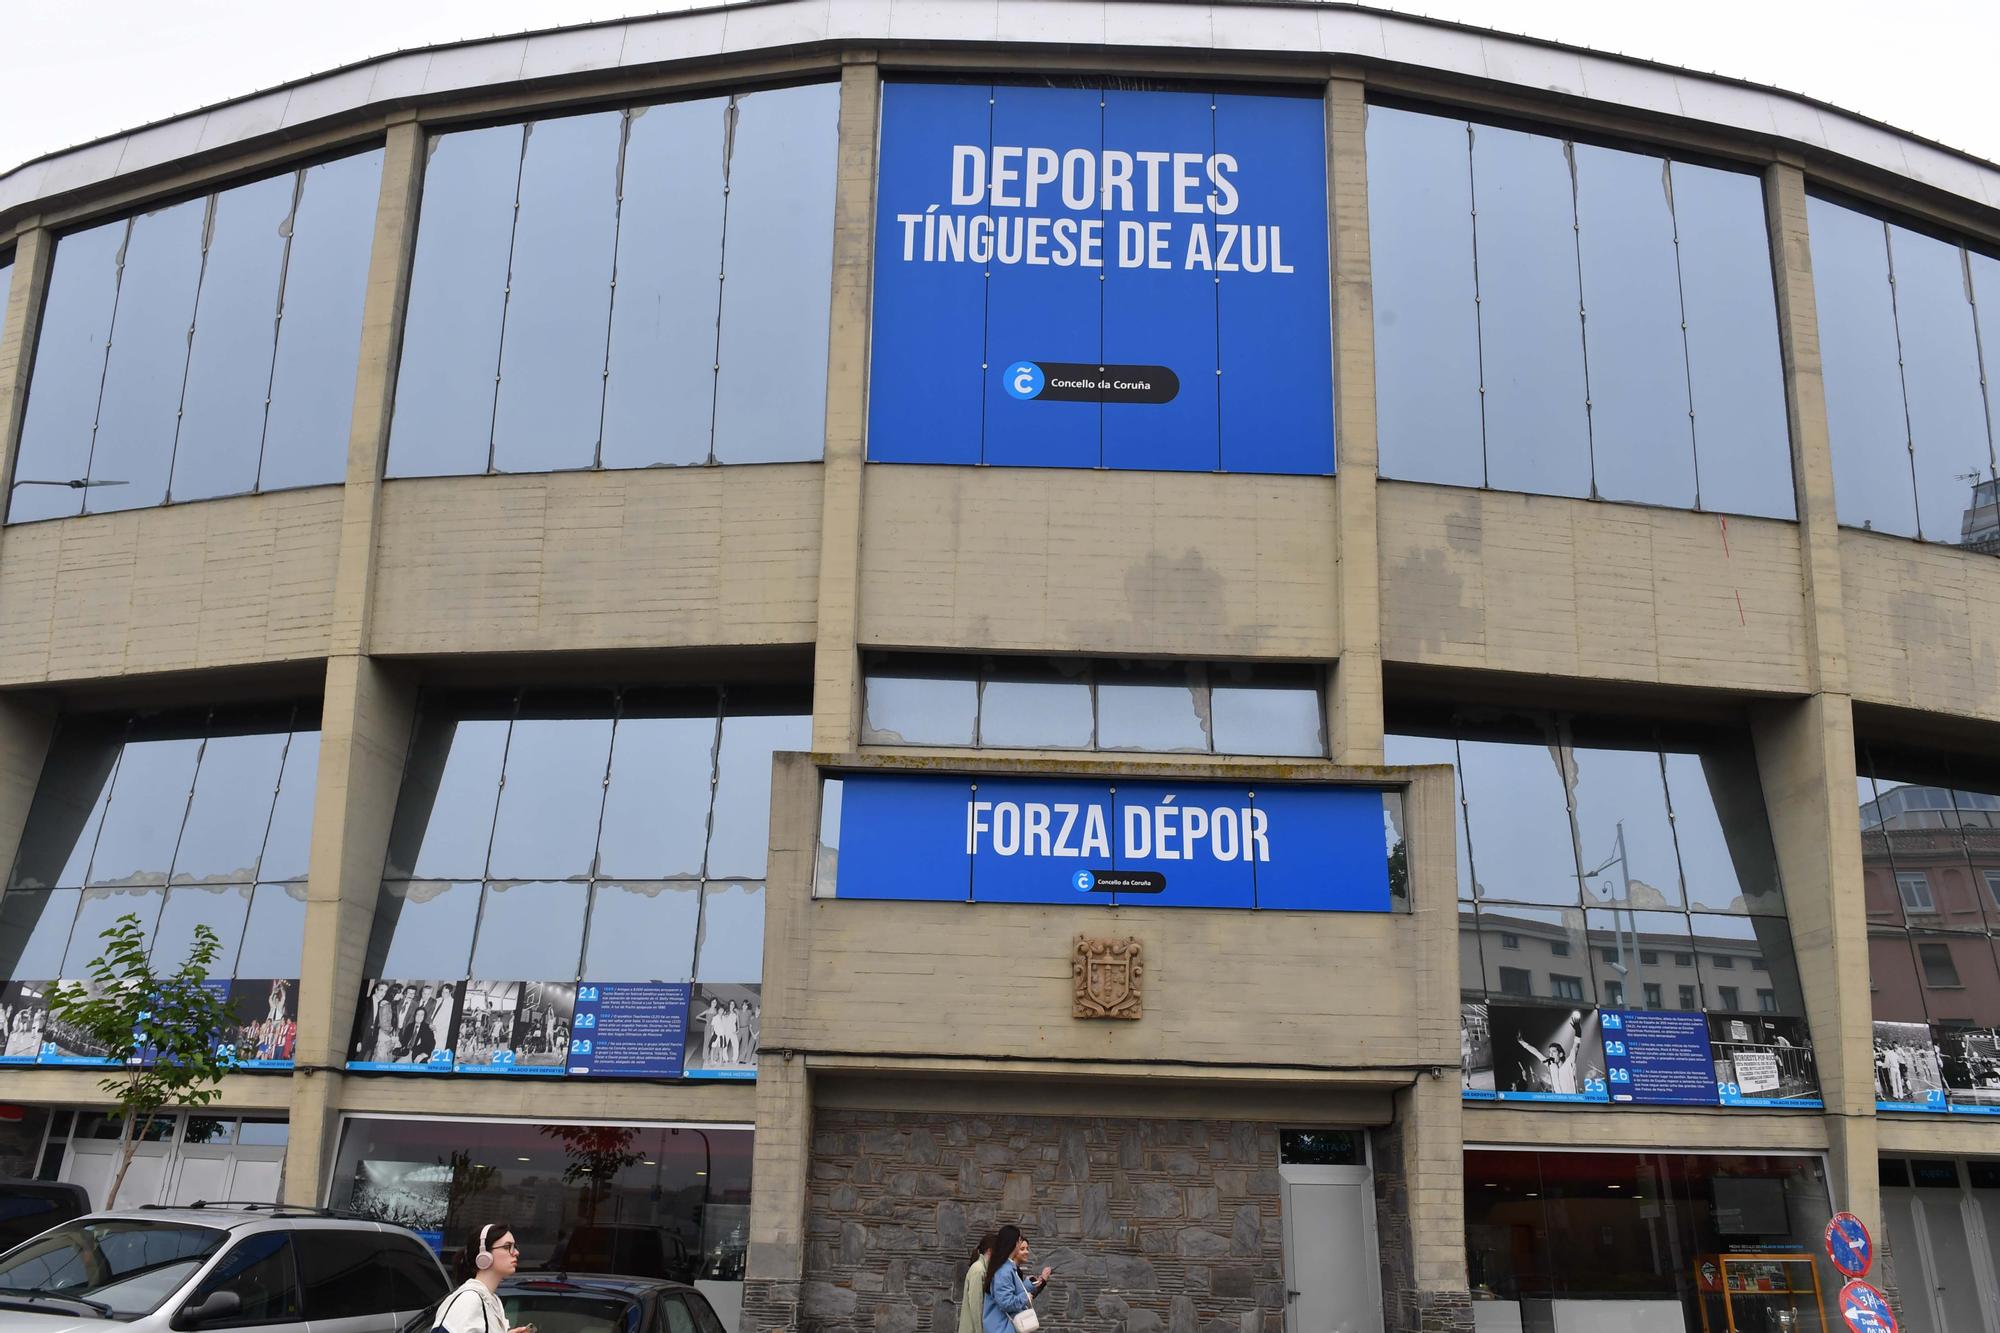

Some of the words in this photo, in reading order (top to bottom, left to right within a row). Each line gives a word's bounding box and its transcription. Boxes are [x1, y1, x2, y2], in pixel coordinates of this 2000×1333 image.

[951, 145, 1239, 215] DEPORTES
[897, 204, 1104, 267] TÍNGUESE
[1118, 220, 1172, 270] DE
[1185, 223, 1294, 273] AZUL
[1051, 378, 1095, 389] Concello
[1098, 380, 1111, 389] da
[1113, 380, 1151, 390] Coruña
[966, 801, 1110, 858] FORZA
[1124, 794, 1270, 862] DÉPOR
[1130, 879, 1151, 887] Coruña
[578, 986, 597, 999] 21
[575, 1013, 594, 1026] 22
[1601, 1014, 1619, 1026] 24
[40, 1042, 57, 1055] 19
[571, 1039, 590, 1052] 23
[1605, 1041, 1623, 1053] 25
[432, 1048, 450, 1062] 21
[492, 1050, 512, 1063] 22
[1609, 1068, 1628, 1081] 26
[1584, 1078, 1604, 1091] 25
[1718, 1083, 1737, 1095] 26
[1926, 1089, 1941, 1101] 27
